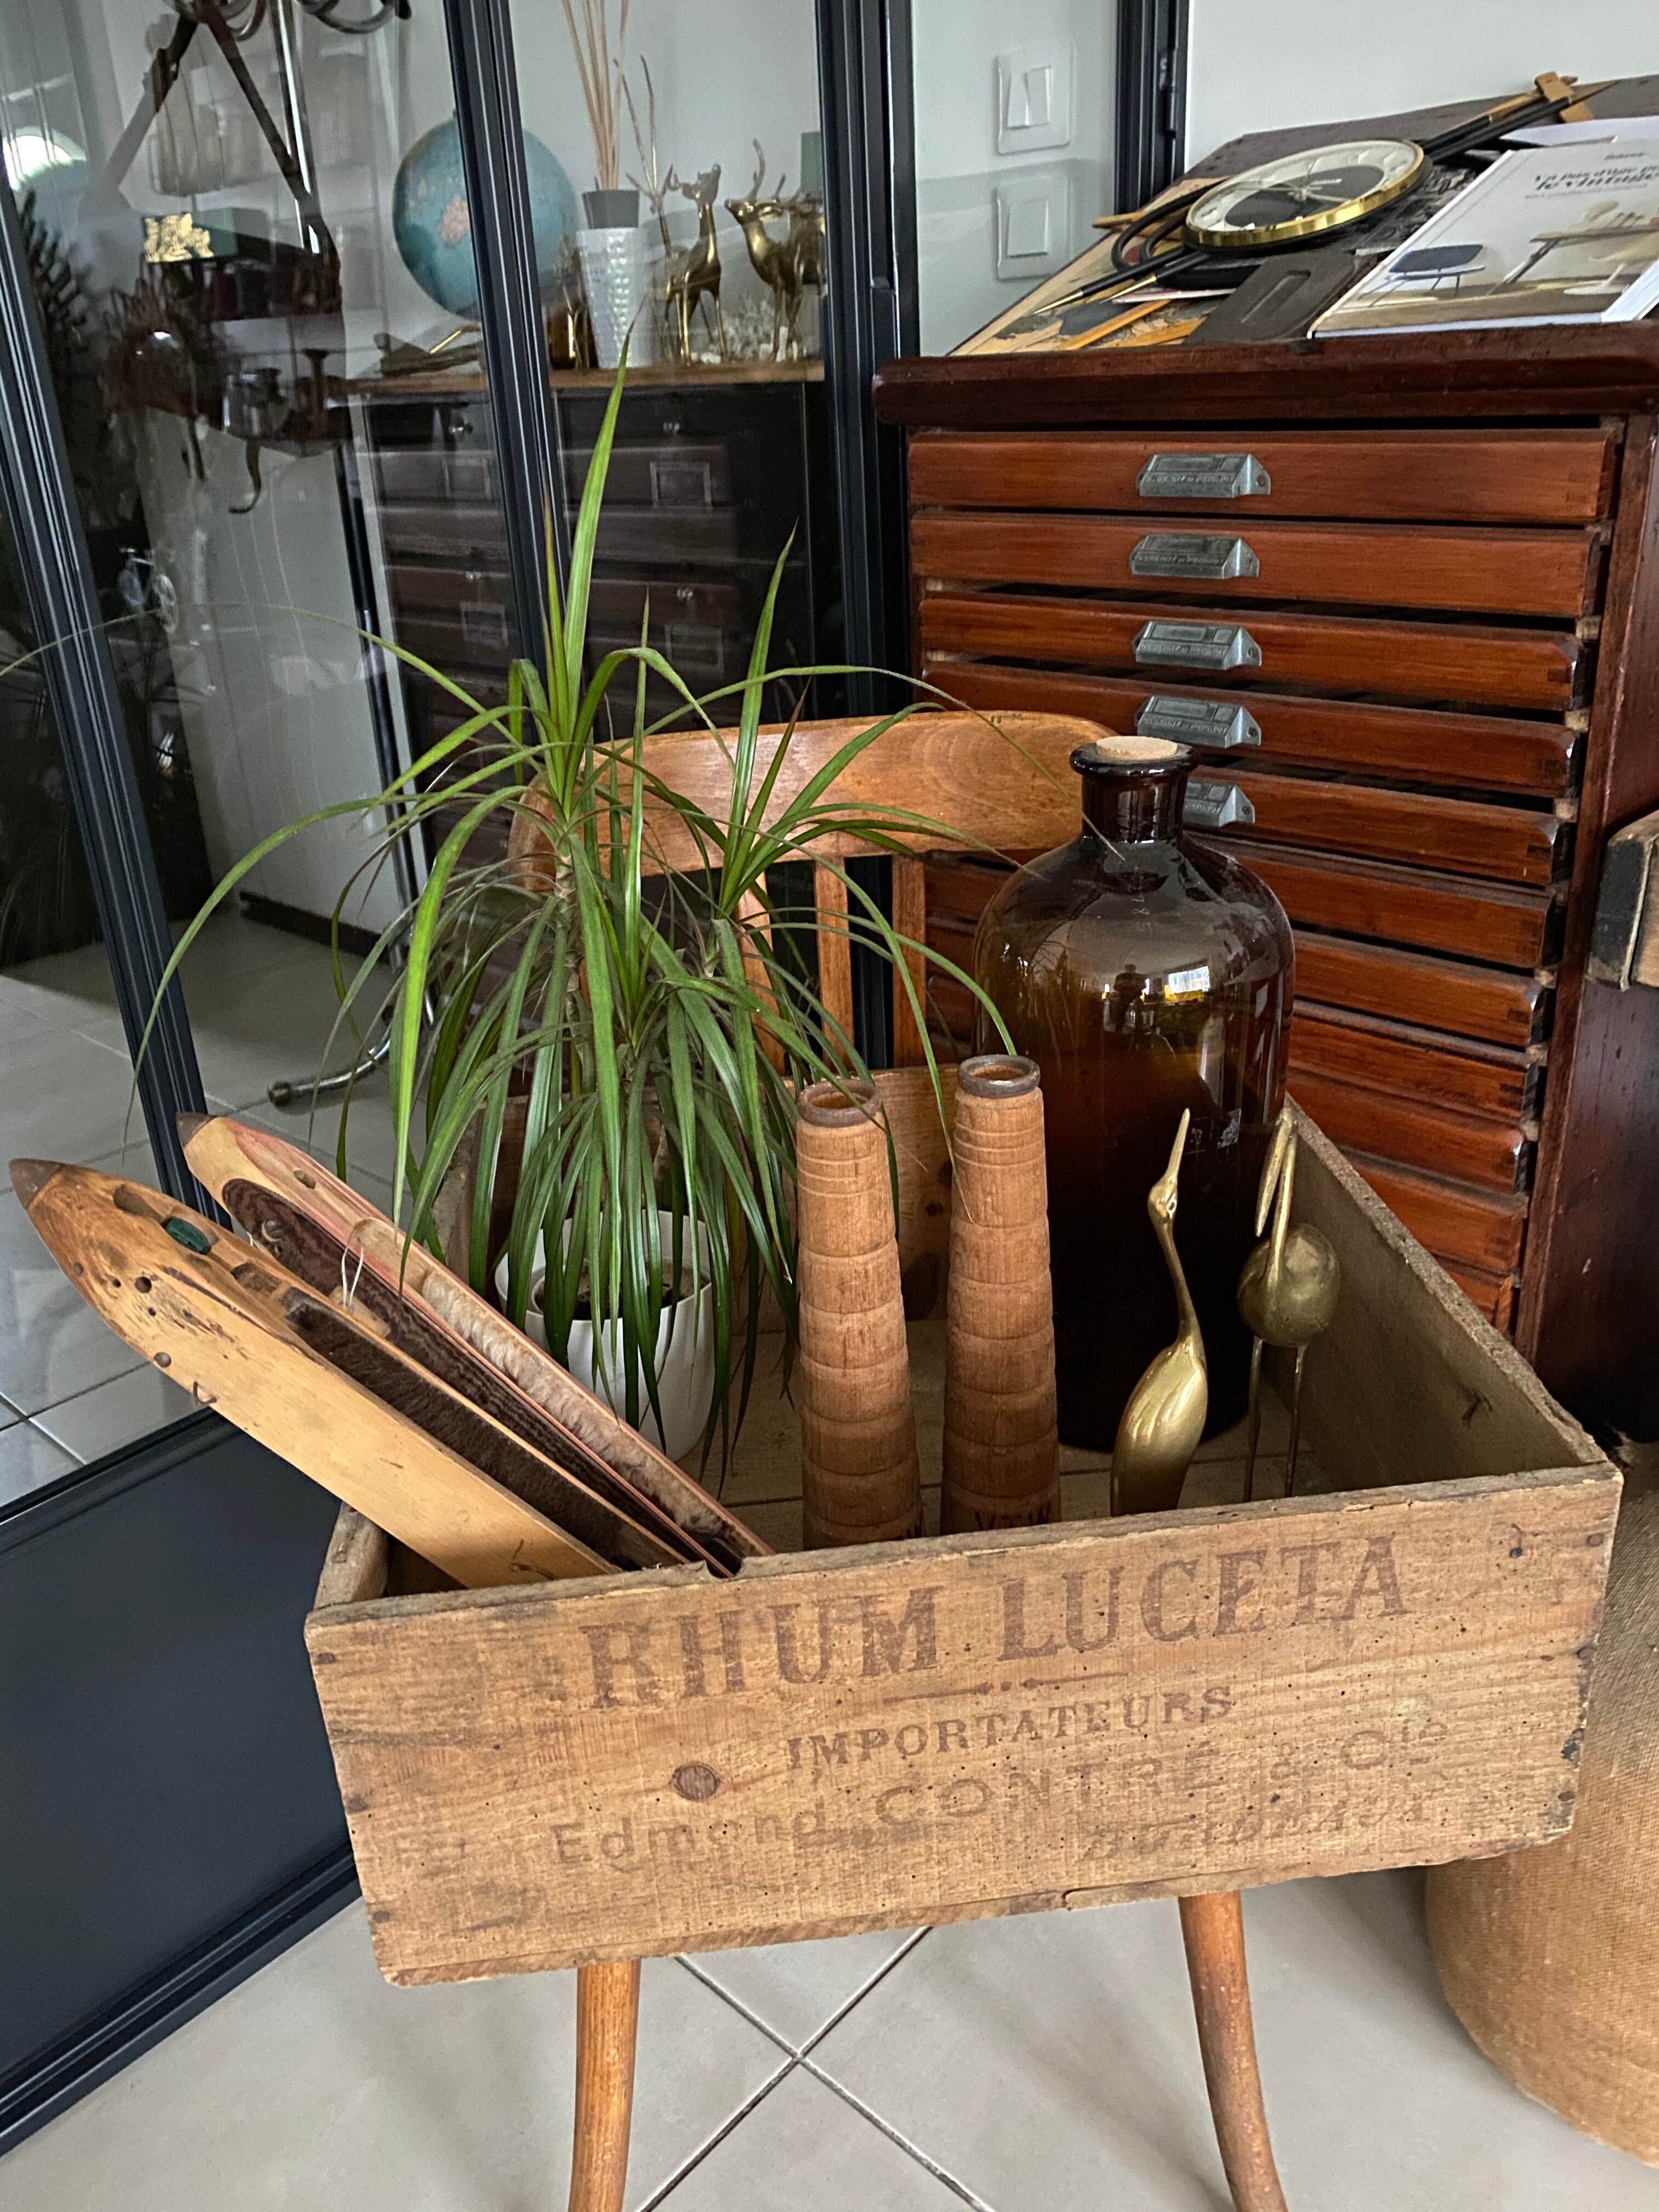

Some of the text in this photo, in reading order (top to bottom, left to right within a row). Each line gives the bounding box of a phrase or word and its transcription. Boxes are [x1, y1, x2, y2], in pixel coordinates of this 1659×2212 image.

[579, 1534, 1413, 1708] RHUM LUCETA
[787, 1686, 1232, 1770] IMPORTATEURS
